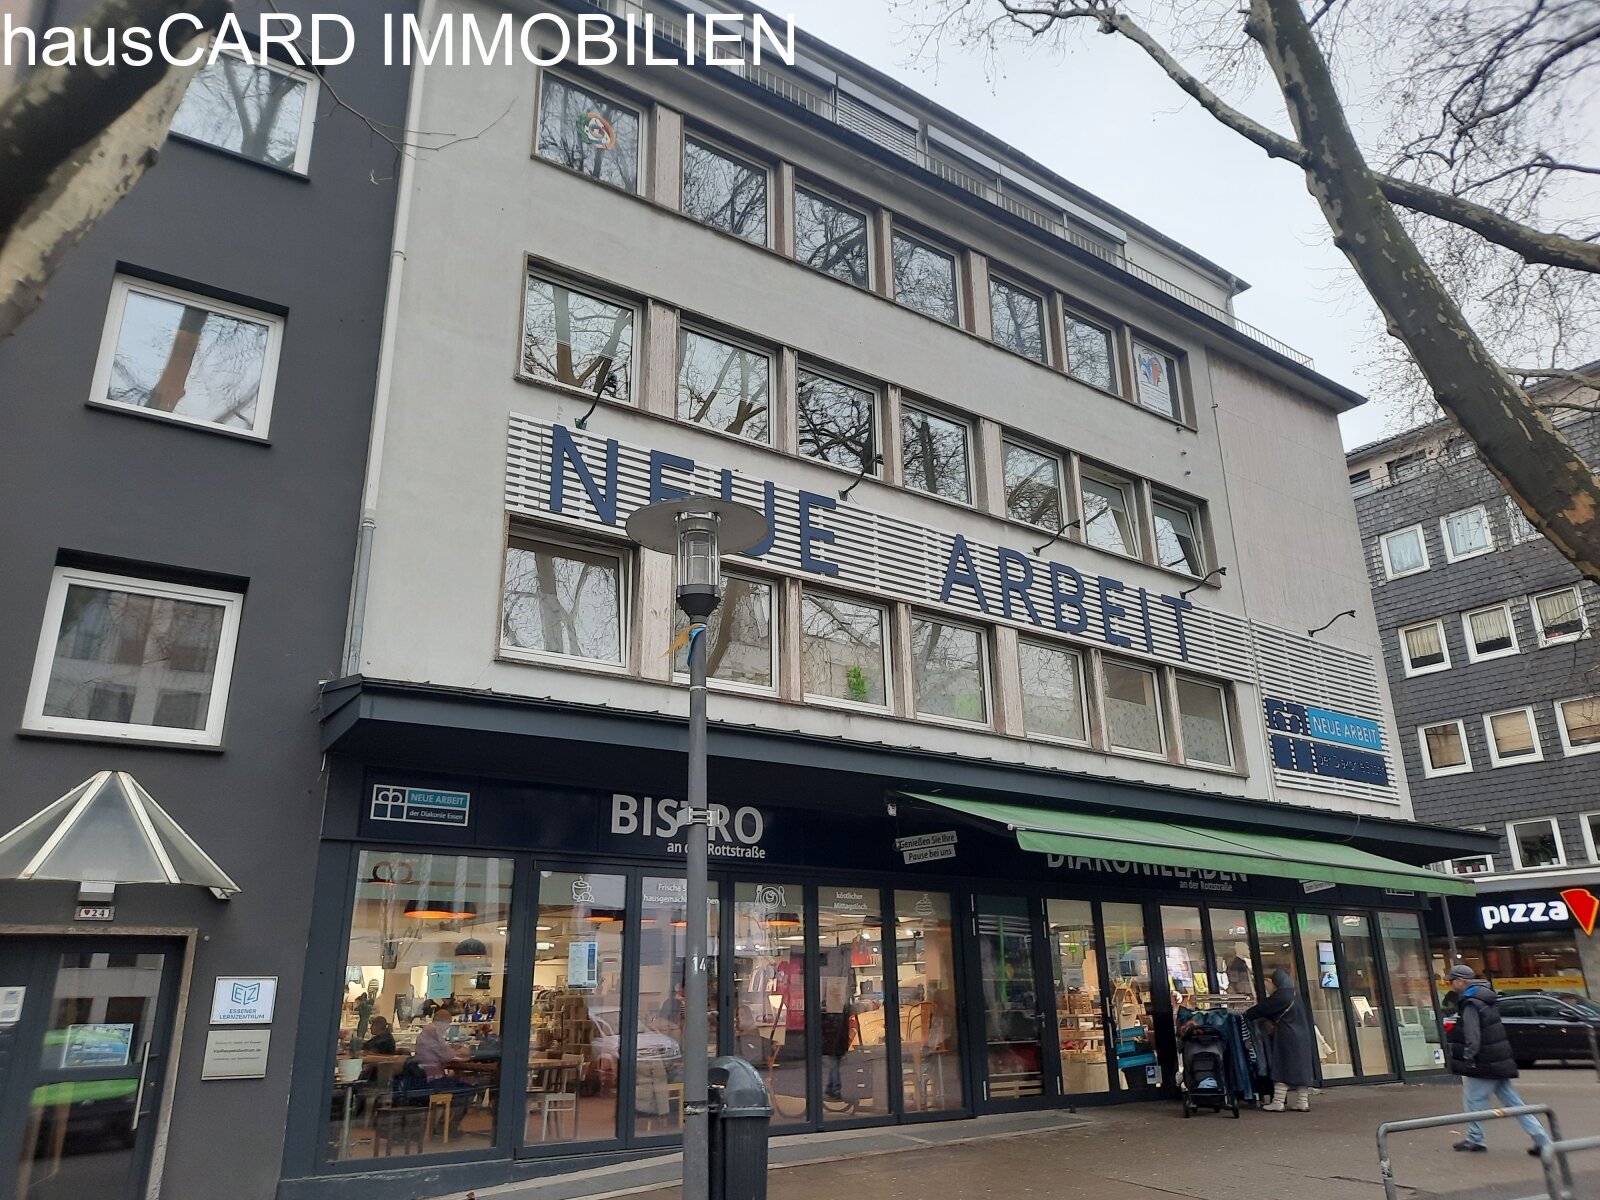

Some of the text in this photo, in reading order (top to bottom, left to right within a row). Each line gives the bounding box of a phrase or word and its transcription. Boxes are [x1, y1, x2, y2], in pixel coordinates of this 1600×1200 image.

[939, 533, 1193, 663] ARBEIT
[1313, 716, 1377, 743] NEUE ARBEIT
[411, 793, 464, 806] NEUE ARBEIT
[409, 809, 463, 820] der Diakonie Essen
[611, 793, 764, 845] BISRO
[900, 837, 931, 849] Genießen
[931, 835, 941, 844] Sie
[667, 843, 682, 854] an
[707, 843, 766, 859] Rottstraße
[908, 848, 952, 861] Pause bei uns
[658, 883, 682, 892] Frische
[91, 909, 105, 917] 24
[1480, 900, 1570, 930] pizza
[692, 954, 706, 973] 14
